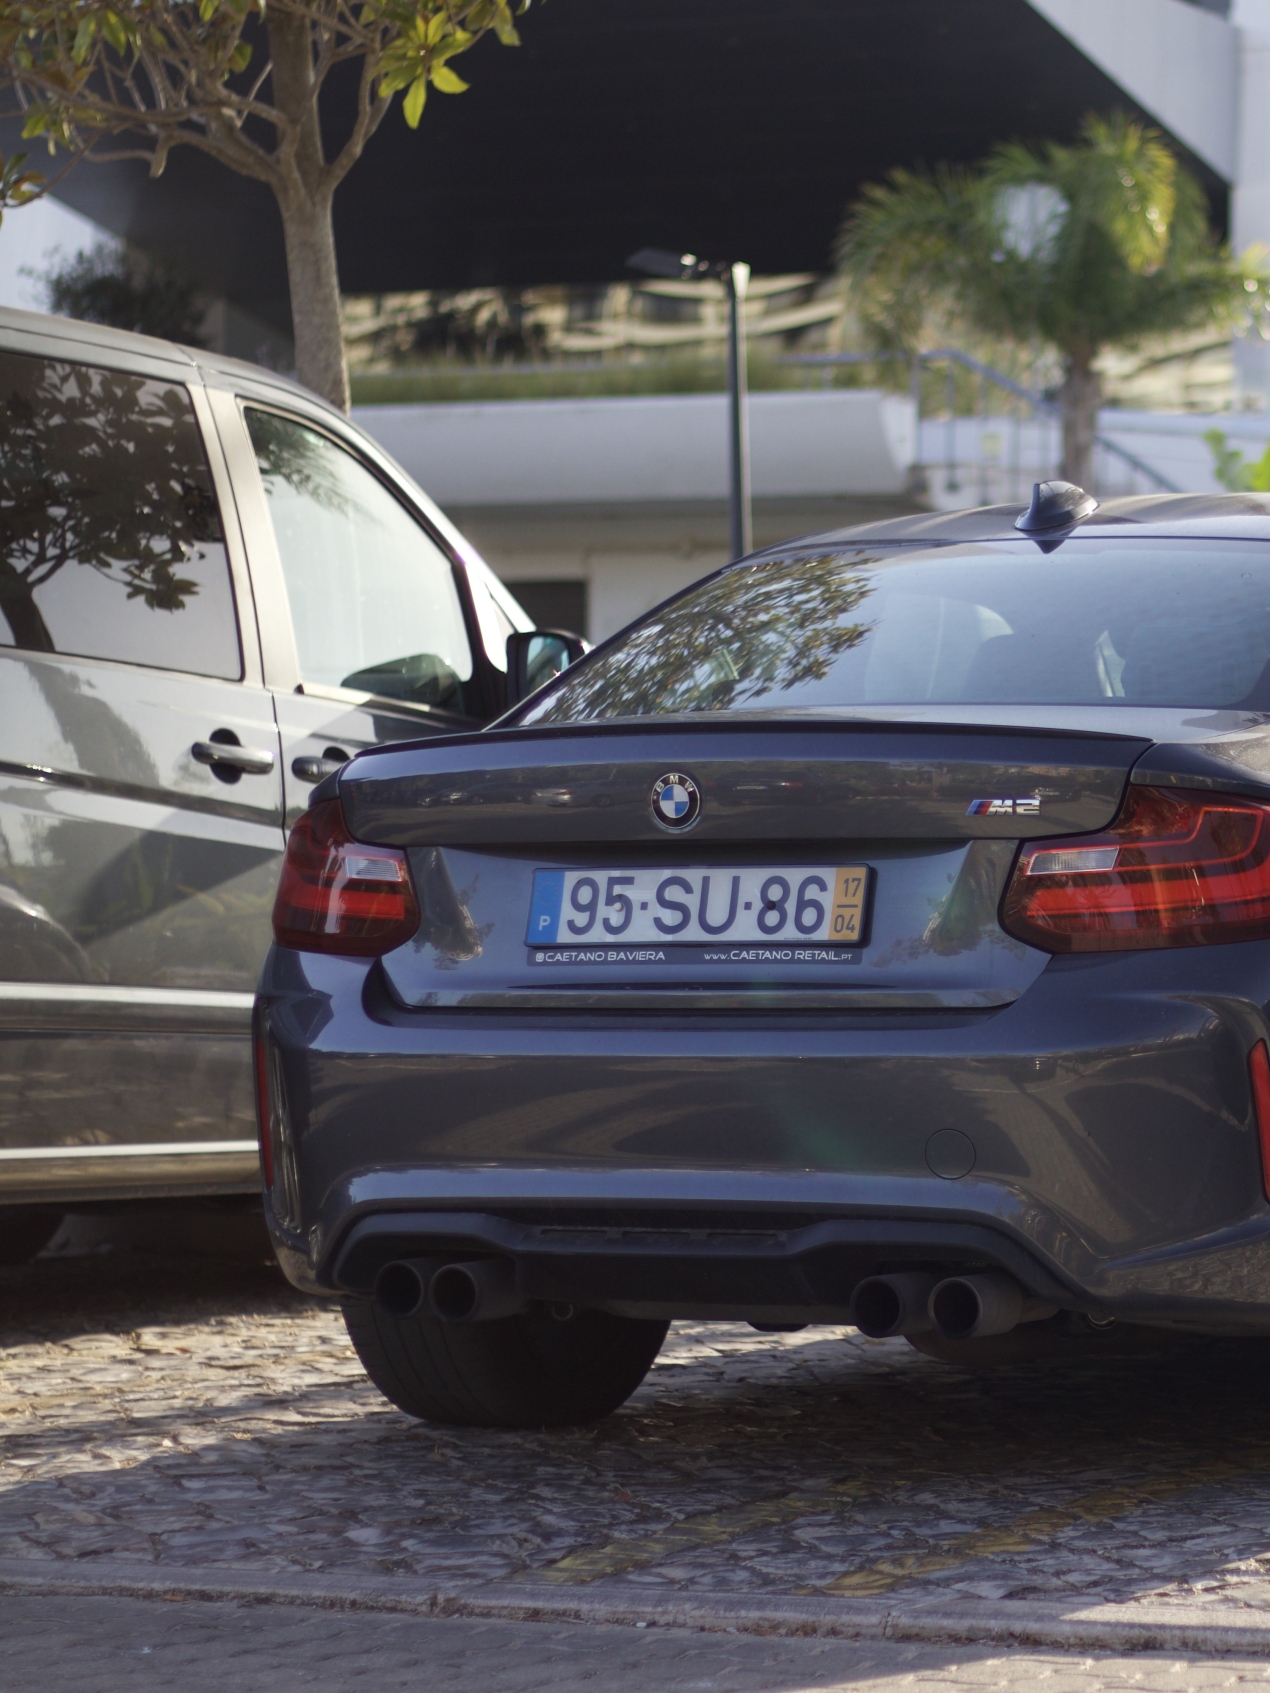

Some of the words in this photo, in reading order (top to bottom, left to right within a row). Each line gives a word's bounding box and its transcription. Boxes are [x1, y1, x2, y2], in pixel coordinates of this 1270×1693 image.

[655, 774, 695, 793] BMW
[985, 799, 1041, 816] M2
[843, 877, 862, 898] 17
[538, 915, 551, 931] P
[833, 914, 856, 934] 04
[607, 951, 666, 962] BAVIERA
